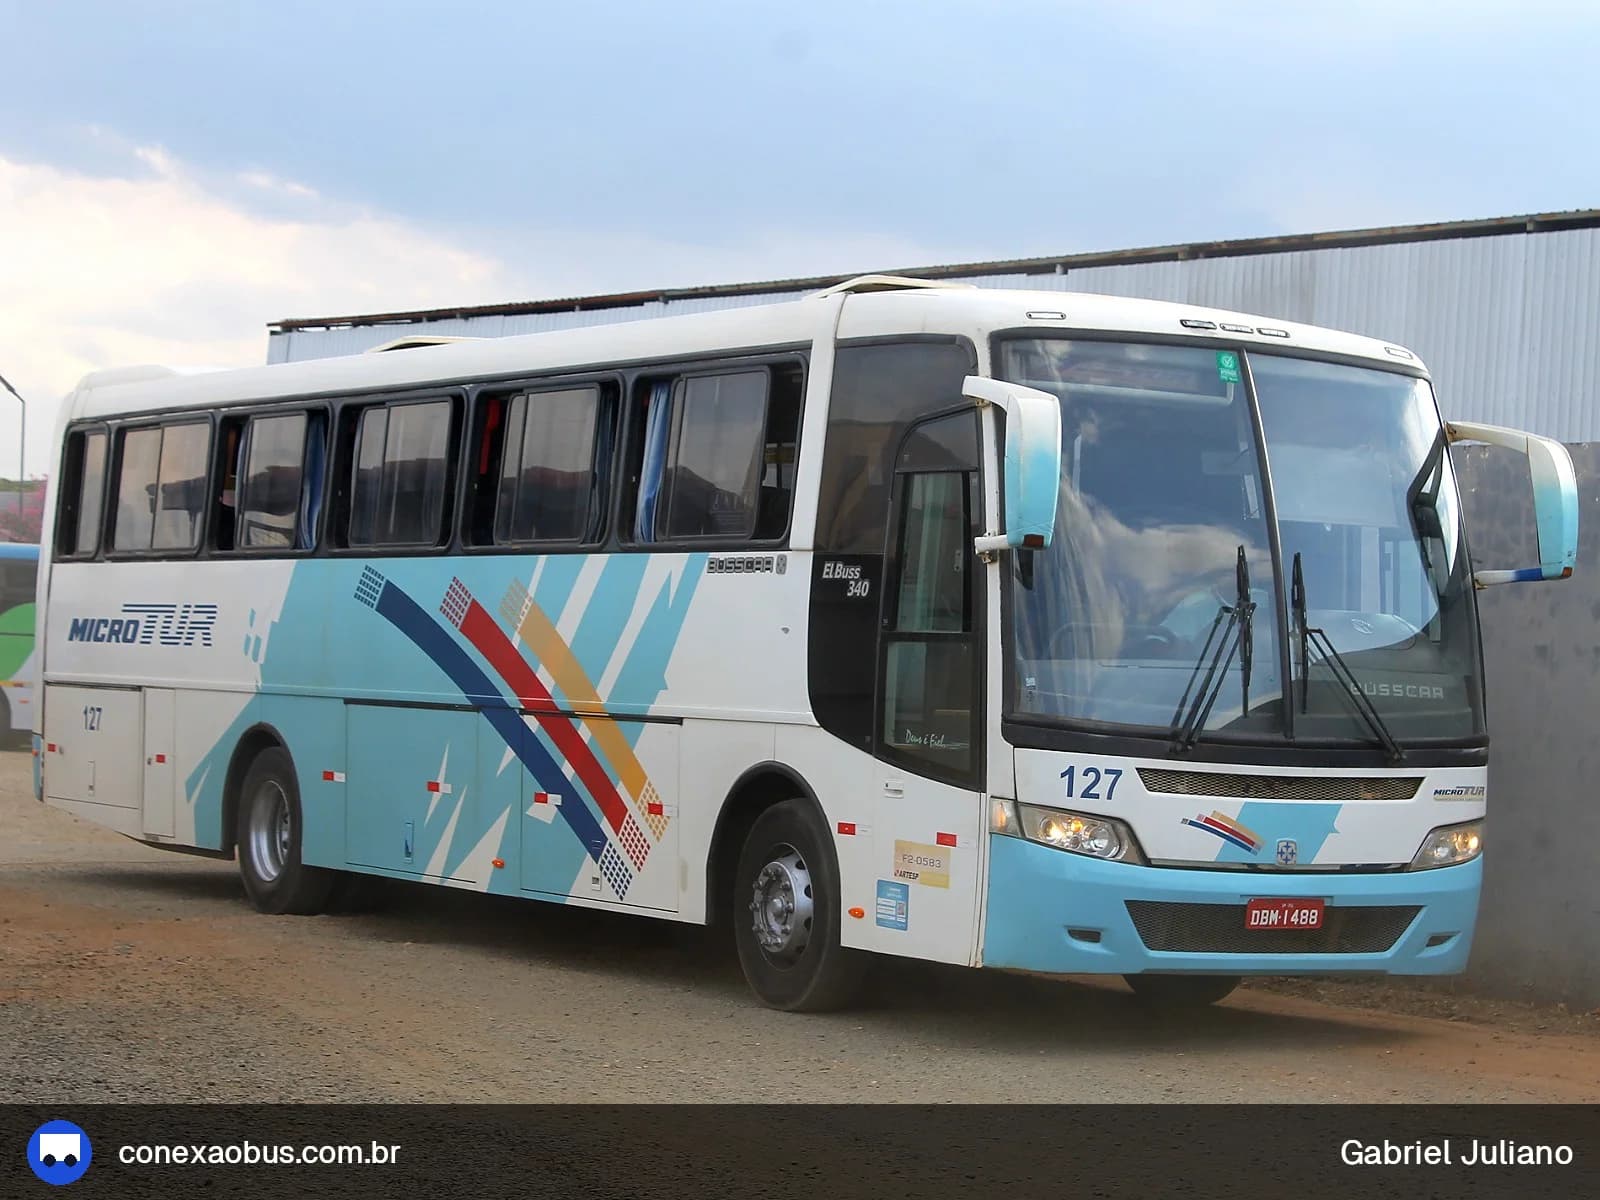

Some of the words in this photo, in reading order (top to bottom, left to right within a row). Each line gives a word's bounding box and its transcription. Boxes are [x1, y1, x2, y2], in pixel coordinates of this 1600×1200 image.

[706, 555, 774, 574] BUSSCAR
[847, 579, 870, 598] 340
[82, 706, 103, 731] 127
[1061, 765, 1123, 802] 127
[902, 853, 942, 869] F2-0583
[898, 870, 920, 880] ARTESP
